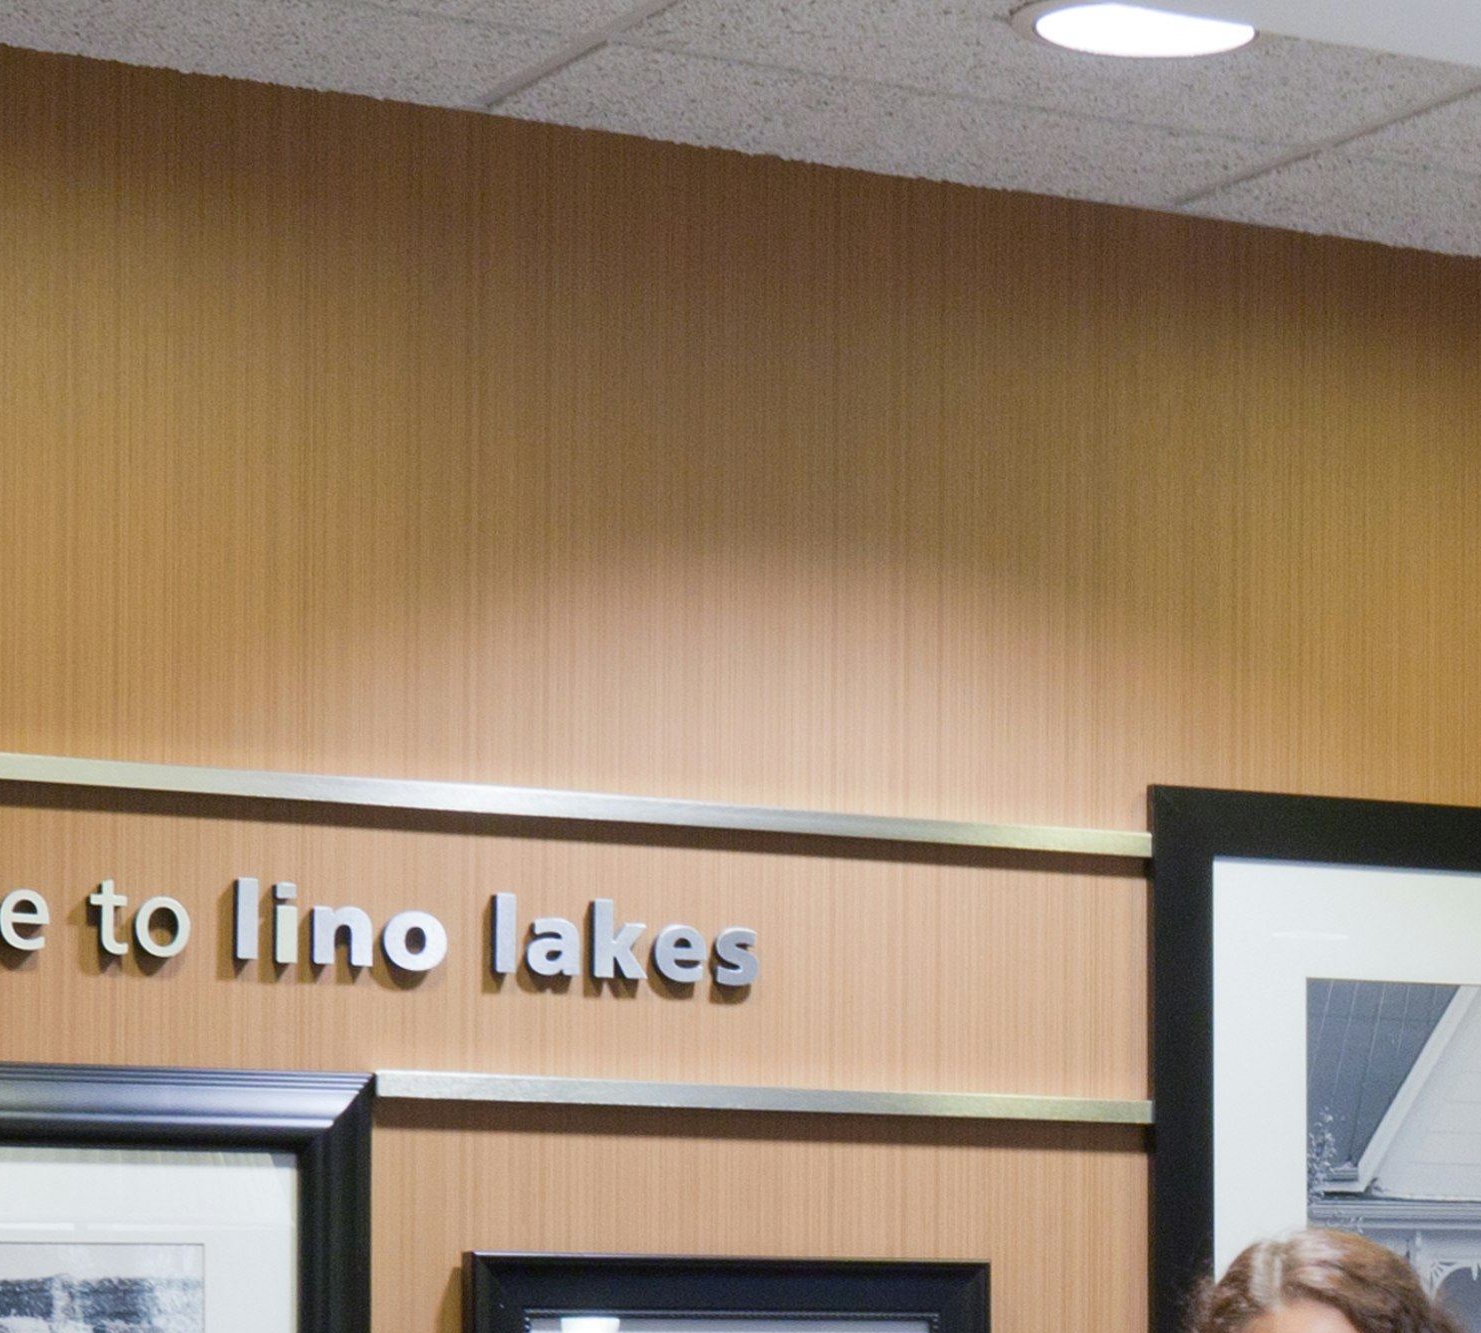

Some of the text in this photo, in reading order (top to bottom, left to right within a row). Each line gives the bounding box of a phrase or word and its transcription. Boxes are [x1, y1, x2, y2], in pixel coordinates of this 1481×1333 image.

[89, 878, 193, 959] to
[232, 876, 450, 972] lino
[492, 892, 762, 990] lakes
